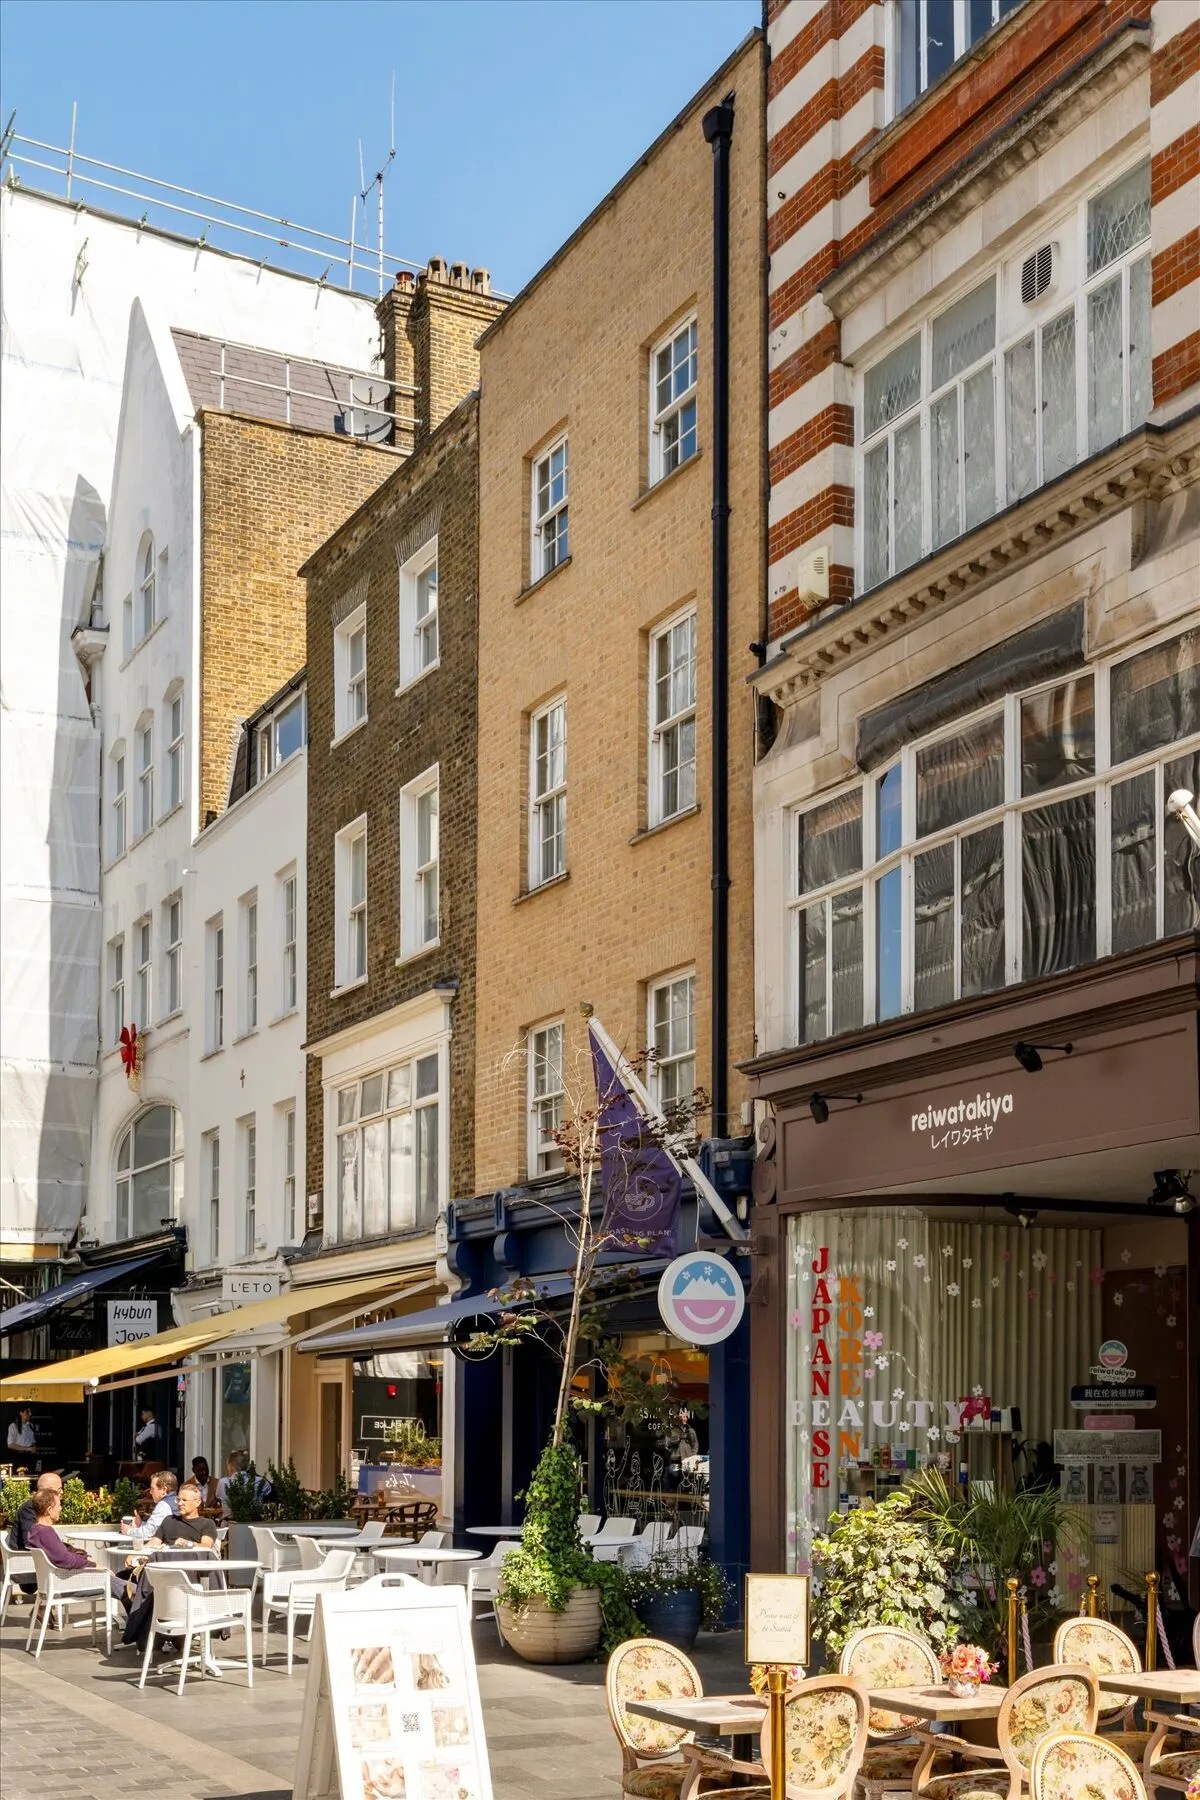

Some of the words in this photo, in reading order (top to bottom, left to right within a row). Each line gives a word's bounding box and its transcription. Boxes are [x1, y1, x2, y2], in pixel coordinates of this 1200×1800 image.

[911, 1092, 1013, 1132] reiwatakiya
[931, 1123, 994, 1149] レイワタキヤ
[231, 1283, 272, 1293] L'ETO
[113, 1305, 152, 1319] kybun
[791, 1400, 969, 1428] BEAUTY
